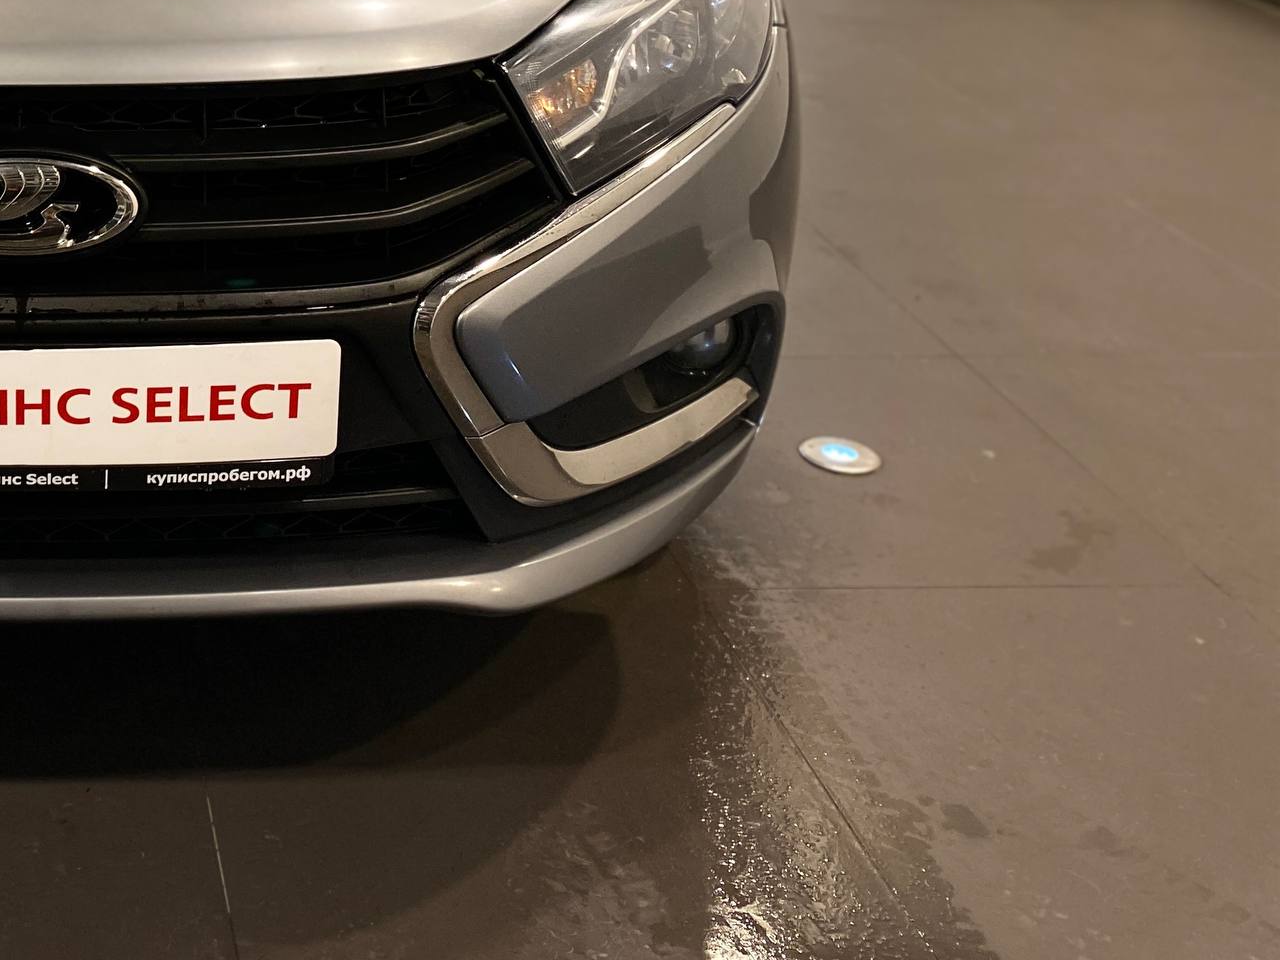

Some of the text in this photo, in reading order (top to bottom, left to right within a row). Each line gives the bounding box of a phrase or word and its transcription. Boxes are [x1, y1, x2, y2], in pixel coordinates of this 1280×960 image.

[111, 382, 312, 424] SELECT
[25, 472, 79, 486] Select
[146, 464, 312, 488] куписпробегом.рф
